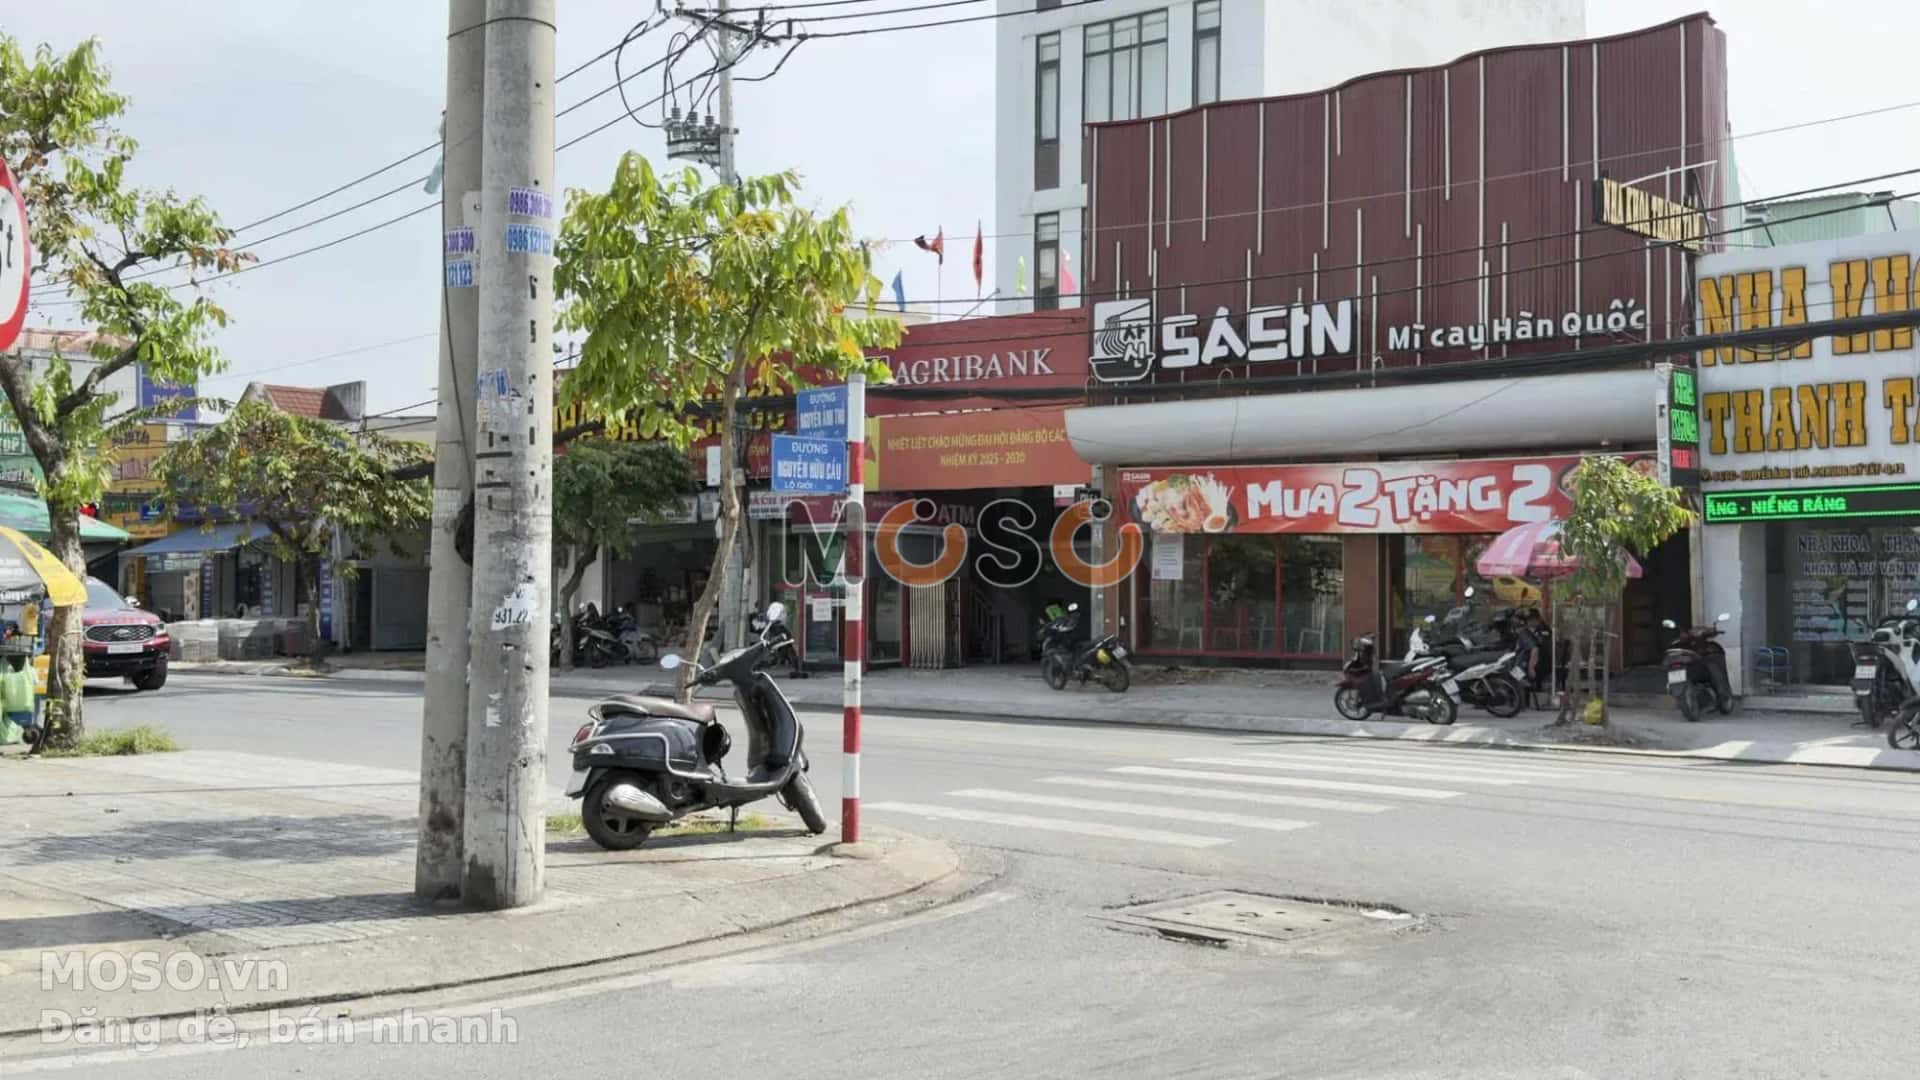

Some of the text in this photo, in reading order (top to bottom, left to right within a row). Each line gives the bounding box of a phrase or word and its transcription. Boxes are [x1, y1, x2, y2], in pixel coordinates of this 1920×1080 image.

[1389, 299, 1645, 350] Mì cay Hàn Quốc
[1700, 267, 1811, 367] NHA
[895, 348, 1055, 386] AGRIBANK
[1703, 381, 1867, 454] THANH
[791, 441, 829, 454] ĐƯỜNG
[938, 503, 976, 526] ATM
[1247, 464, 1551, 526] MUA 2 TẶNG 2
